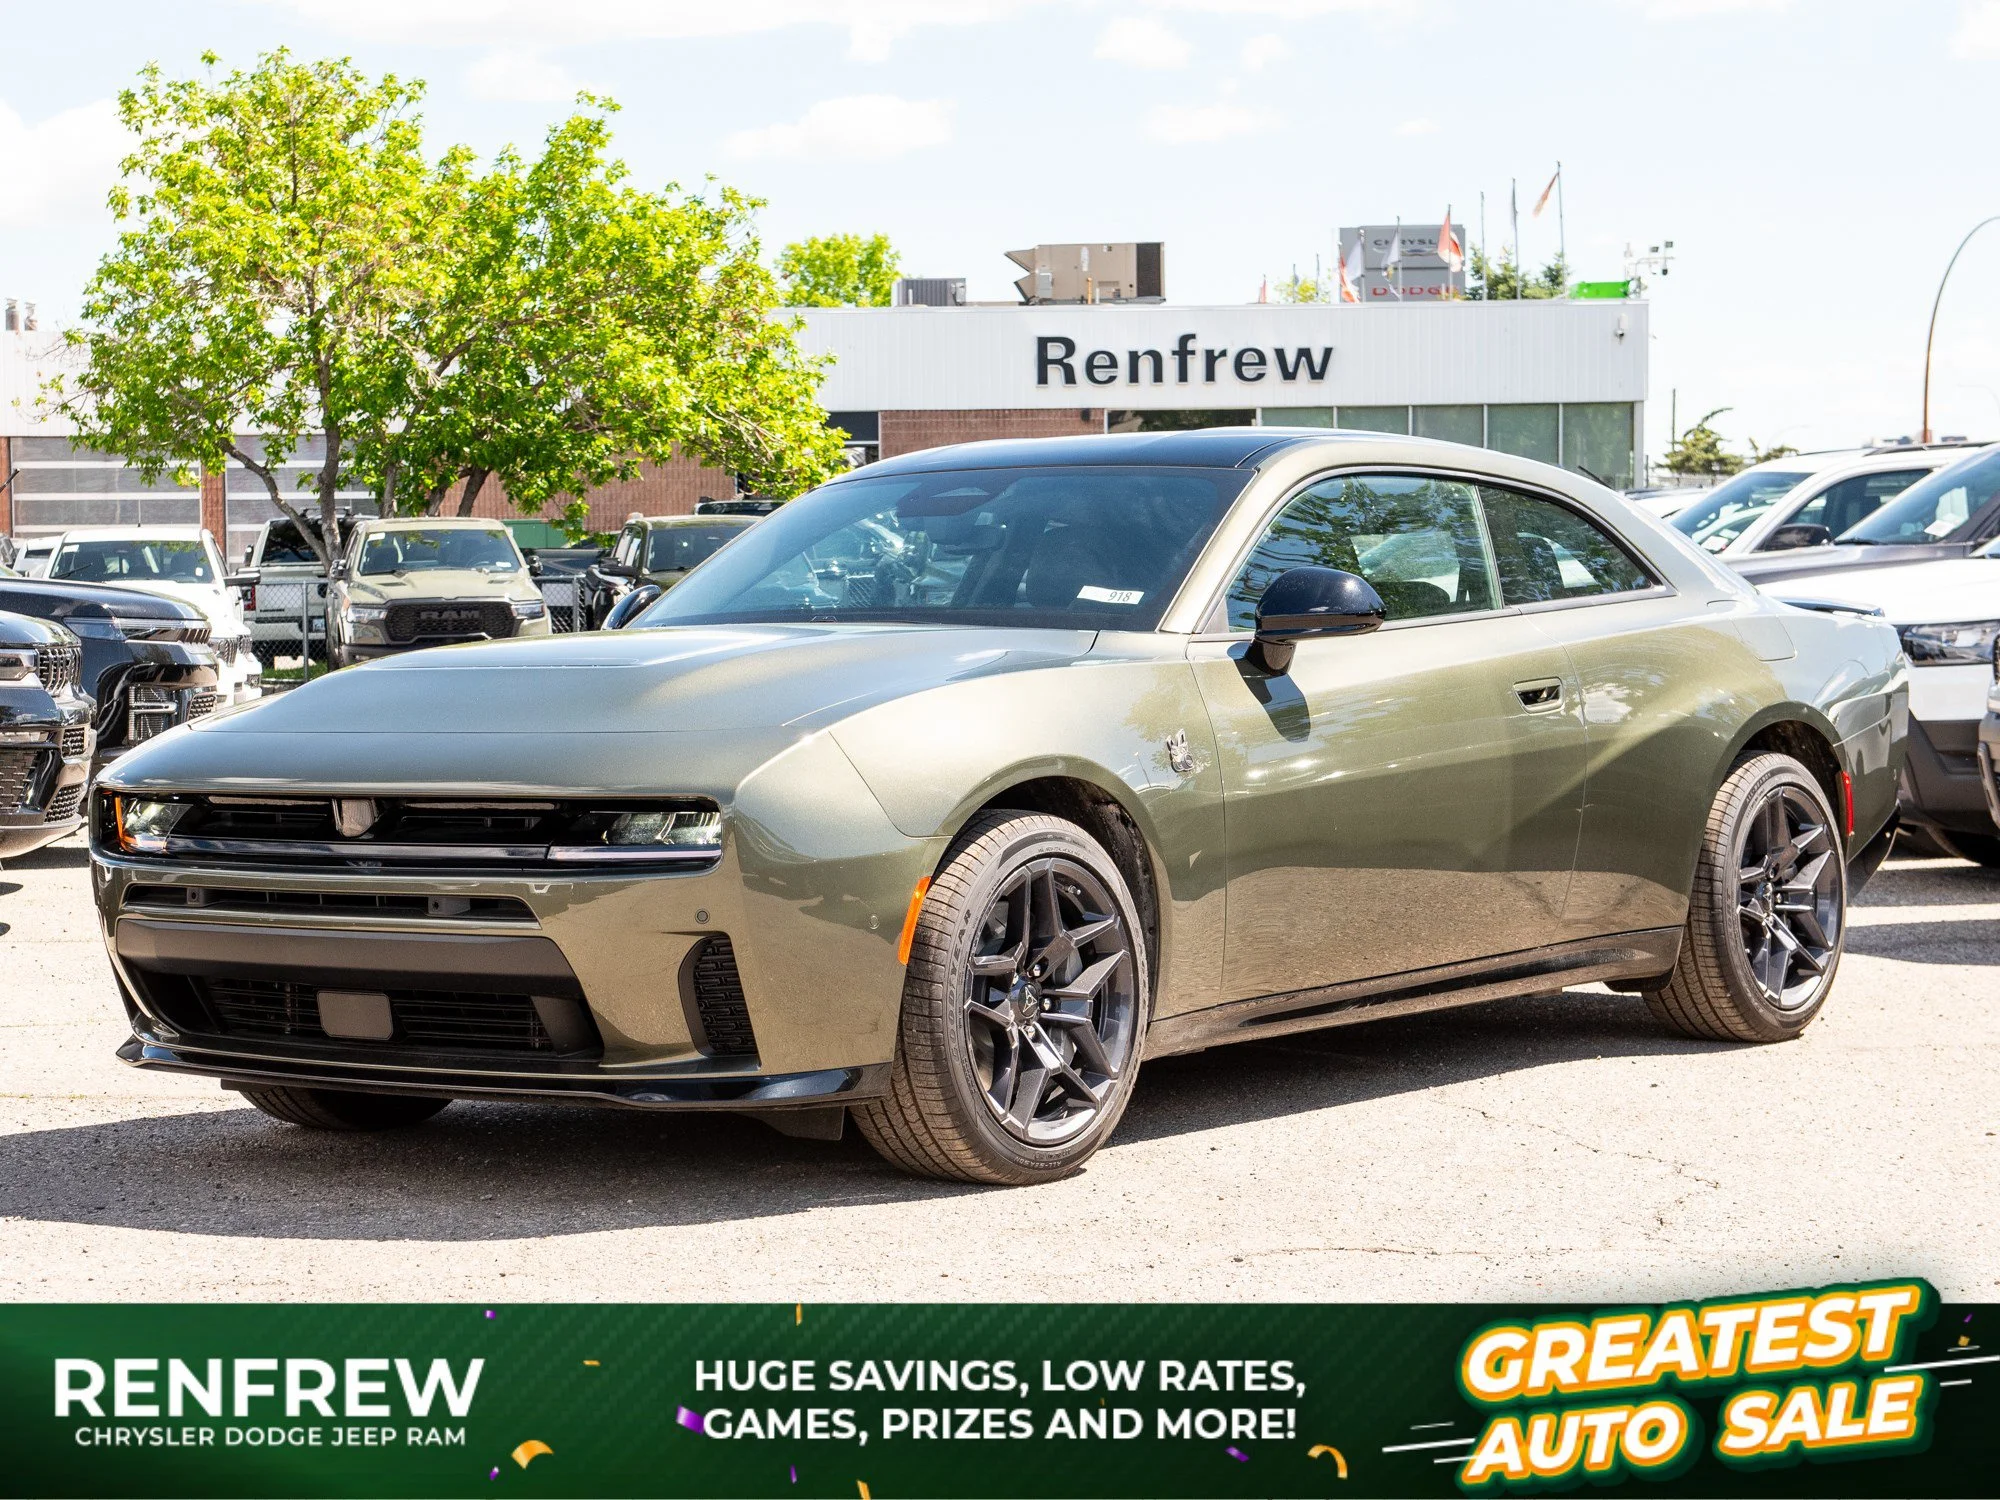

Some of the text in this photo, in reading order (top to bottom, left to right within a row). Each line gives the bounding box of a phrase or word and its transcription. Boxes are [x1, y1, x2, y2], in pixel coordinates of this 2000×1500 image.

[1035, 333, 1334, 386] Renfrew
[1108, 591, 1133, 602] 918
[420, 610, 479, 619] RAM
[950, 908, 972, 1062] GOODYEAR
